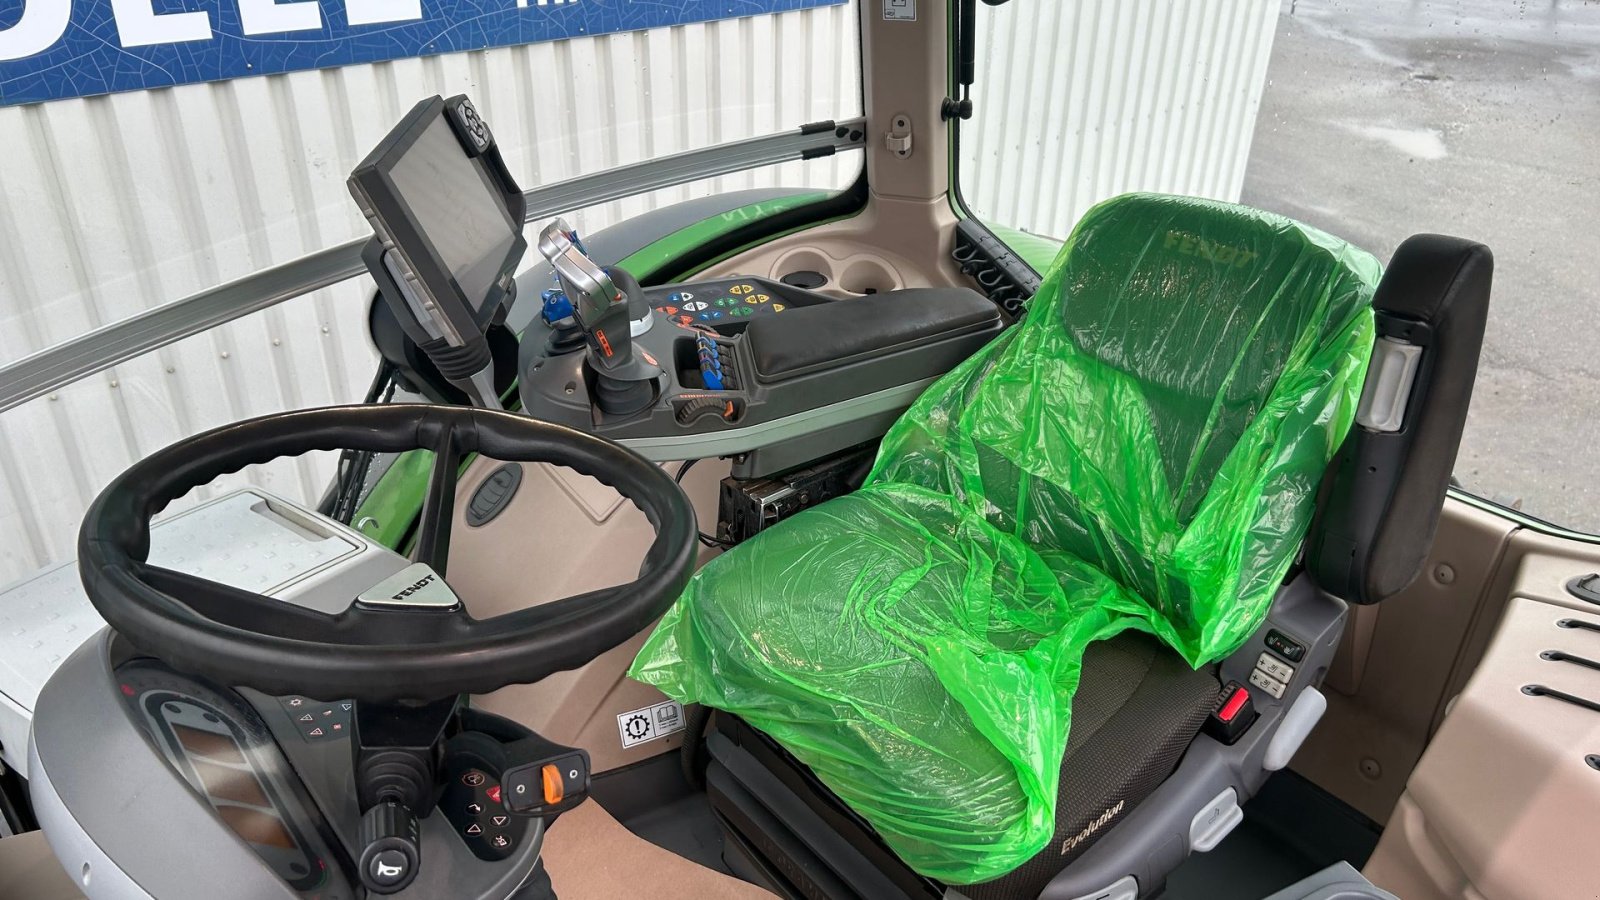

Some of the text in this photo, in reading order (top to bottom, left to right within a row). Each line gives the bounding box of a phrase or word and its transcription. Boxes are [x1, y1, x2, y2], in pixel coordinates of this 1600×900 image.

[1163, 230, 1259, 268] FENDT
[392, 574, 435, 601] FENDT
[1061, 799, 1125, 856] Evolution
